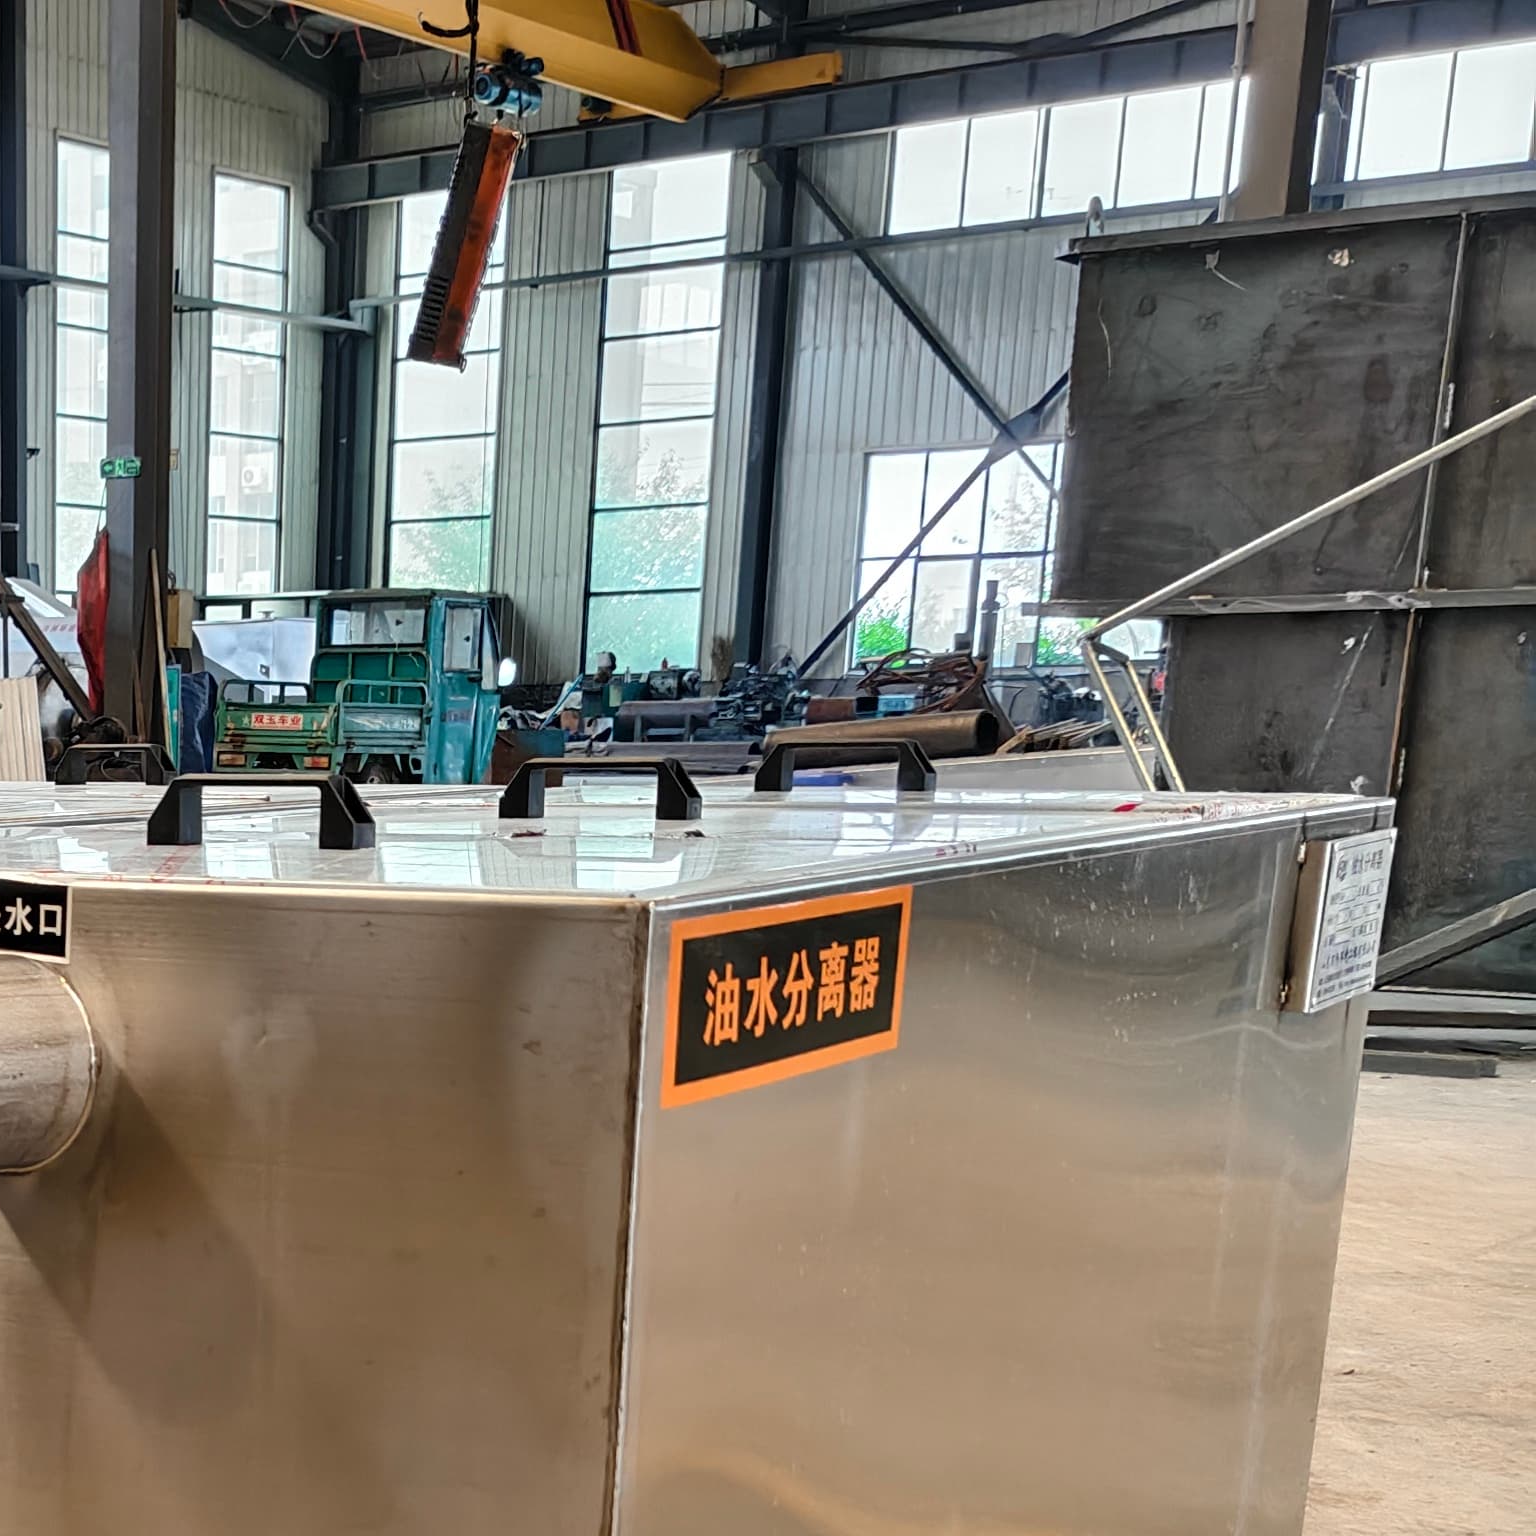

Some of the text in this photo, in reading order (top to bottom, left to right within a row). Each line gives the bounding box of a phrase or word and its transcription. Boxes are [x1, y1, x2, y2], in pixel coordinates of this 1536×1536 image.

[702, 935, 881, 1047] 油水分离器
